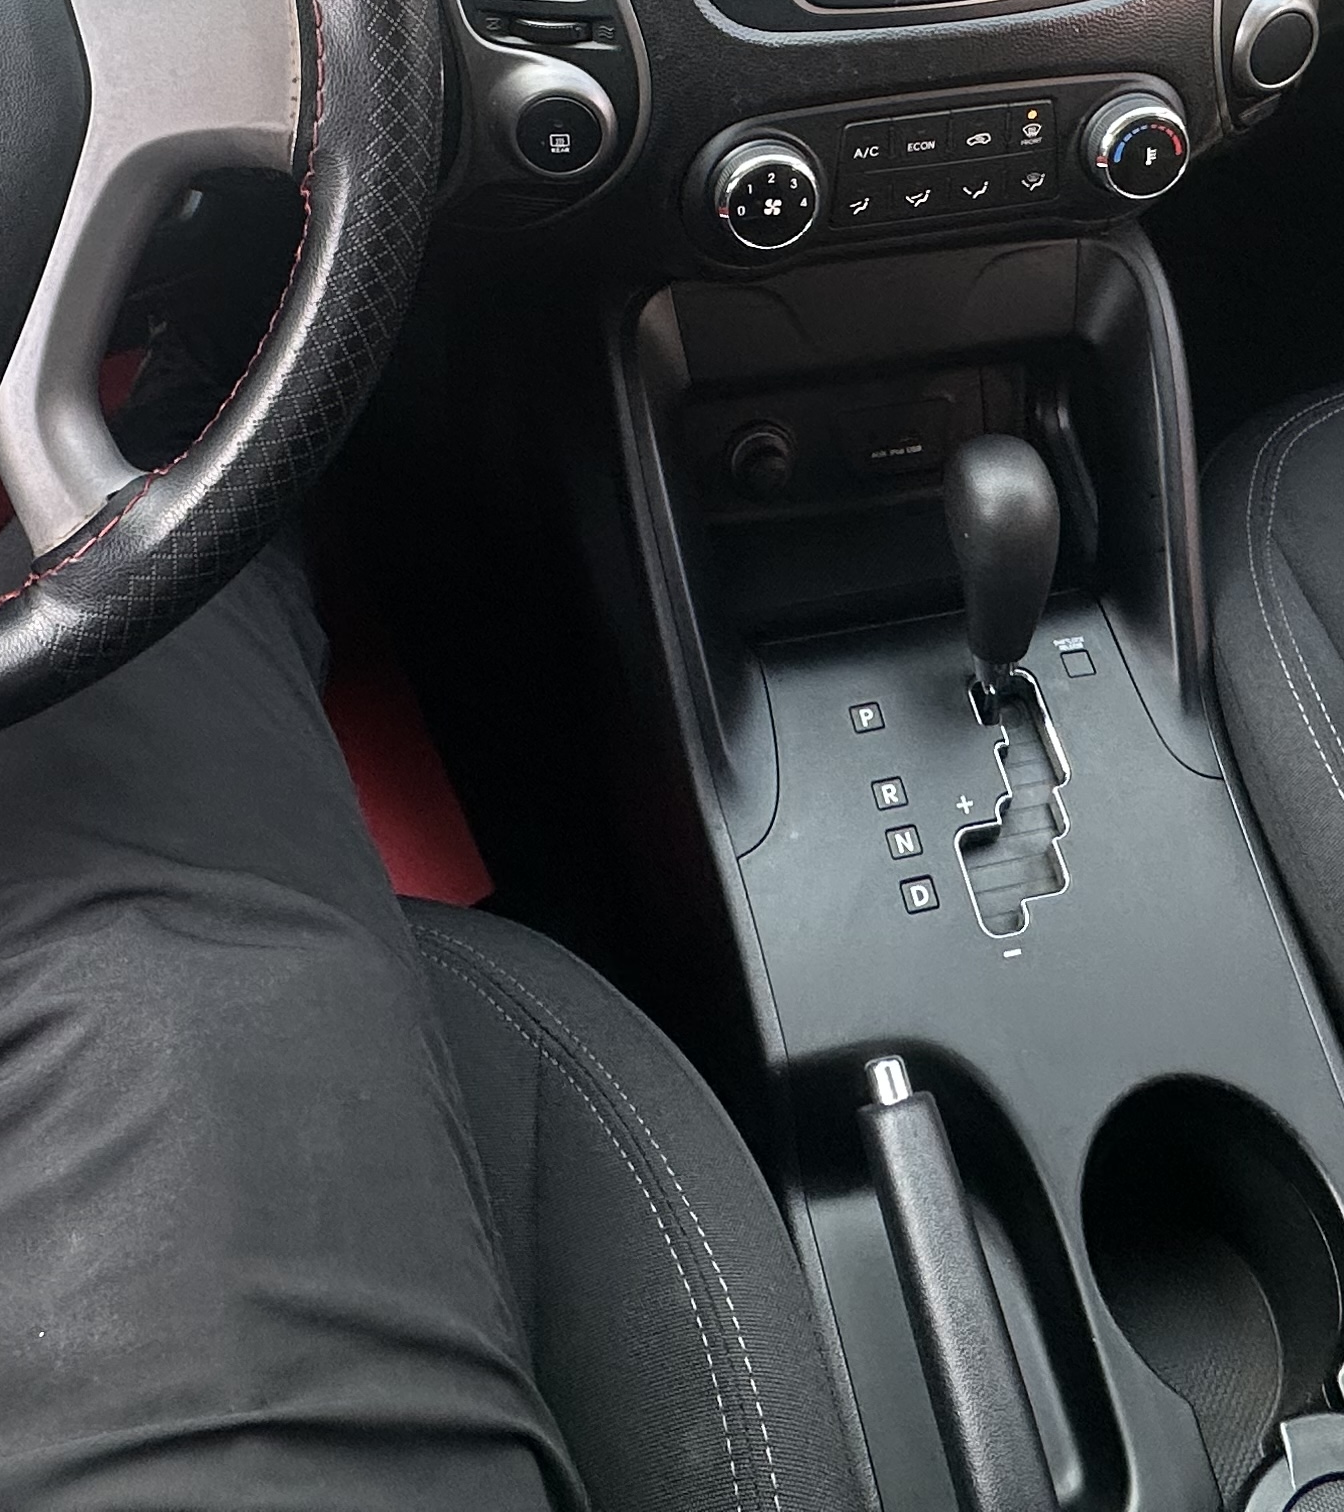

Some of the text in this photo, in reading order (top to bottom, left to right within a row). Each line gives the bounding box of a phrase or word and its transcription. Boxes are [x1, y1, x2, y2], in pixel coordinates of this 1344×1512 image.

[907, 140, 936, 152] ECON
[853, 146, 880, 159] A/C
[768, 173, 775, 184] 2
[790, 178, 798, 189] 3
[747, 184, 752, 194] 1
[800, 197, 808, 207] 4
[737, 206, 746, 216] 0
[859, 708, 874, 728] P
[881, 783, 899, 804] R
[896, 832, 915, 854] N
[910, 885, 930, 906] D
